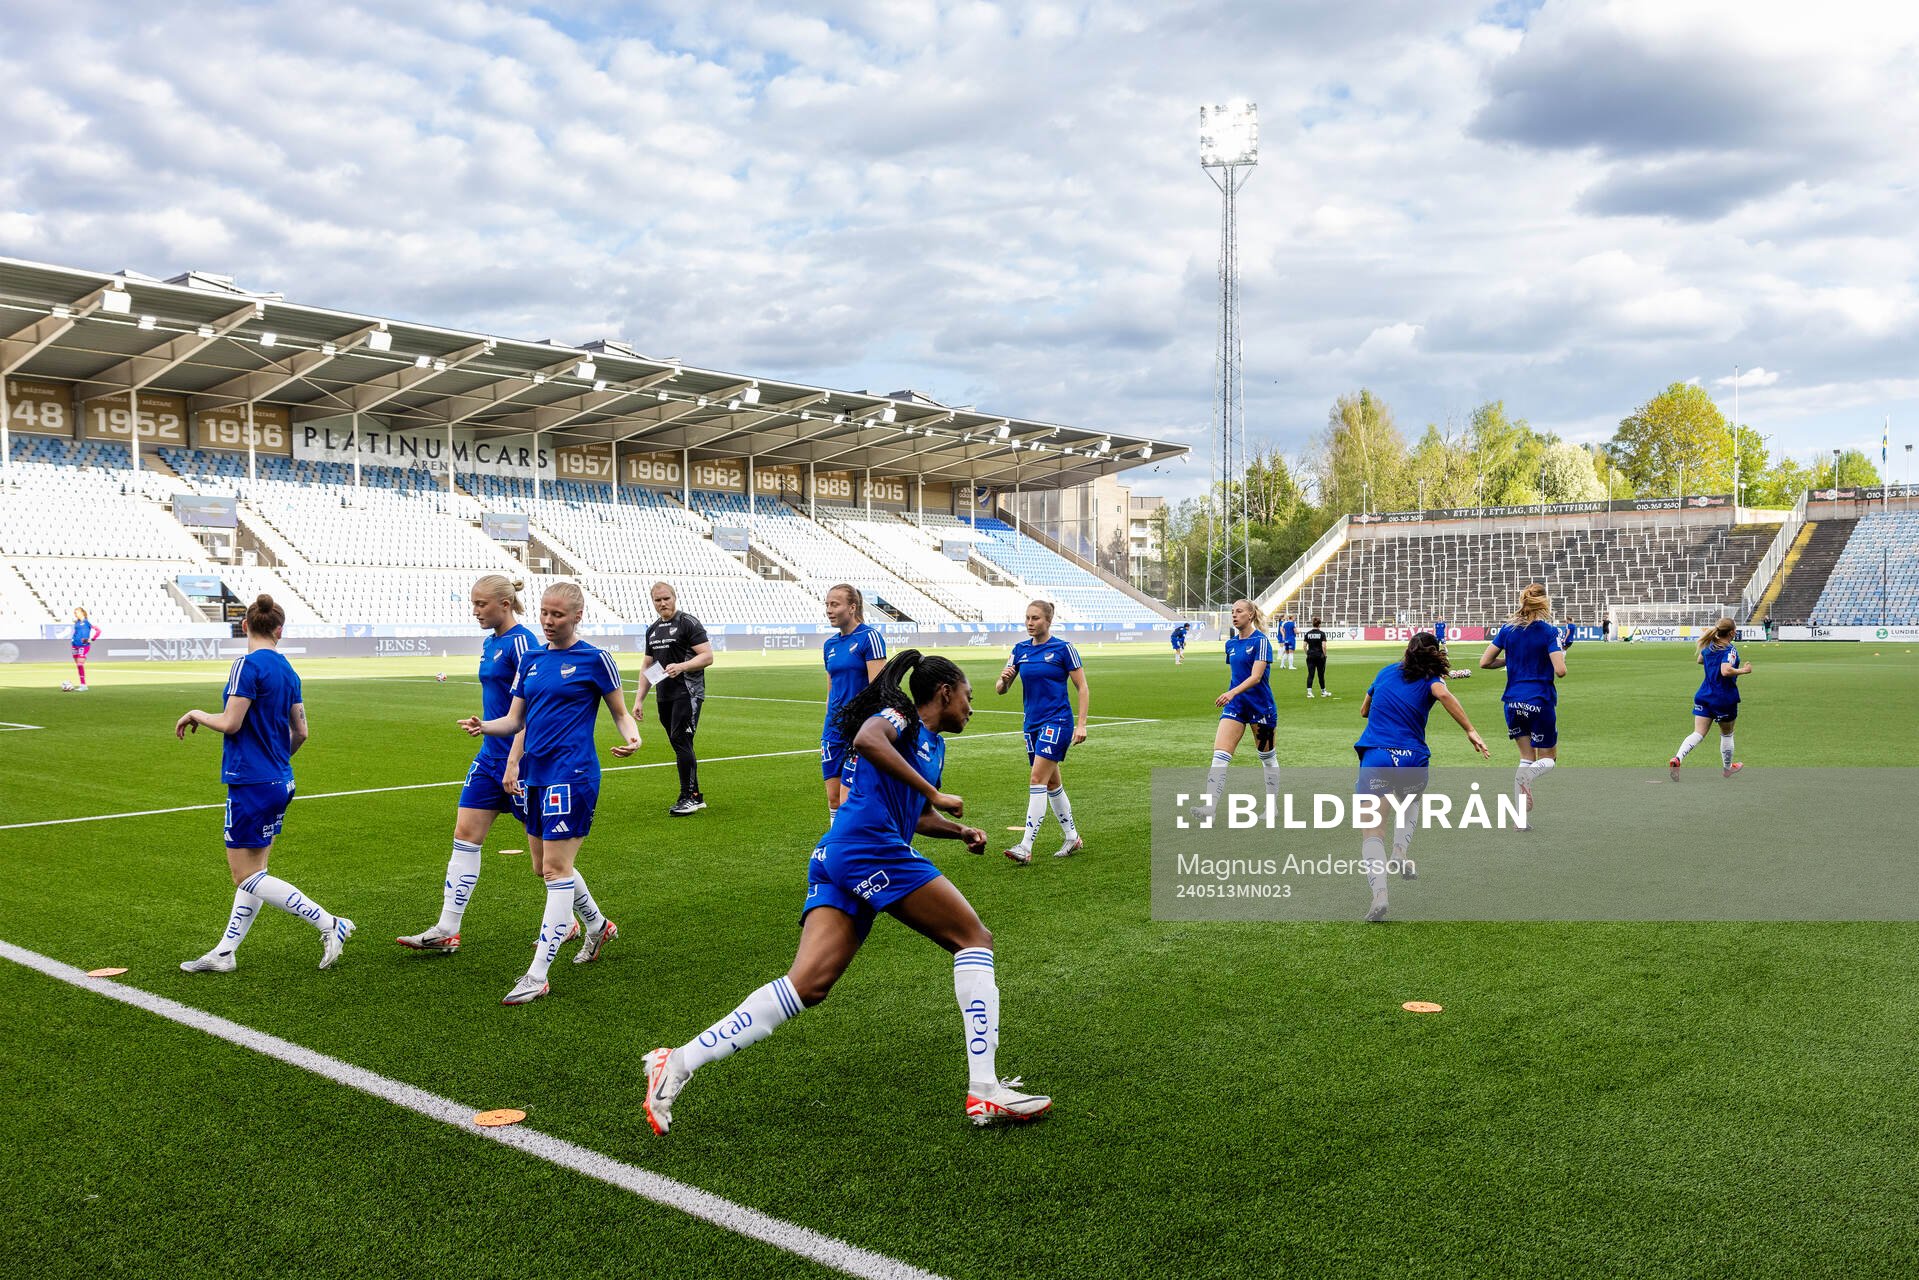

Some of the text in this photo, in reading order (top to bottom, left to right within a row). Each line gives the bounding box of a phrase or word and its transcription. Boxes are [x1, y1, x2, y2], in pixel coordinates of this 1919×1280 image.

[92, 406, 180, 439] 1952
[204, 417, 283, 448] 1956
[559, 451, 612, 477] 1957
[628, 458, 681, 483] 1960
[693, 465, 742, 488] 1962
[754, 470, 799, 492] 1963
[862, 480, 904, 501] 2015
[1452, 509, 1469, 517] ETT
[1489, 507, 1505, 516] ETT
[1642, 626, 1676, 636] weber
[375, 638, 414, 652] JENS
[285, 891, 321, 922] Ocab
[226, 904, 253, 939] Ocab
[698, 1009, 753, 1048] Ocab
[965, 999, 988, 1056] Ocab
